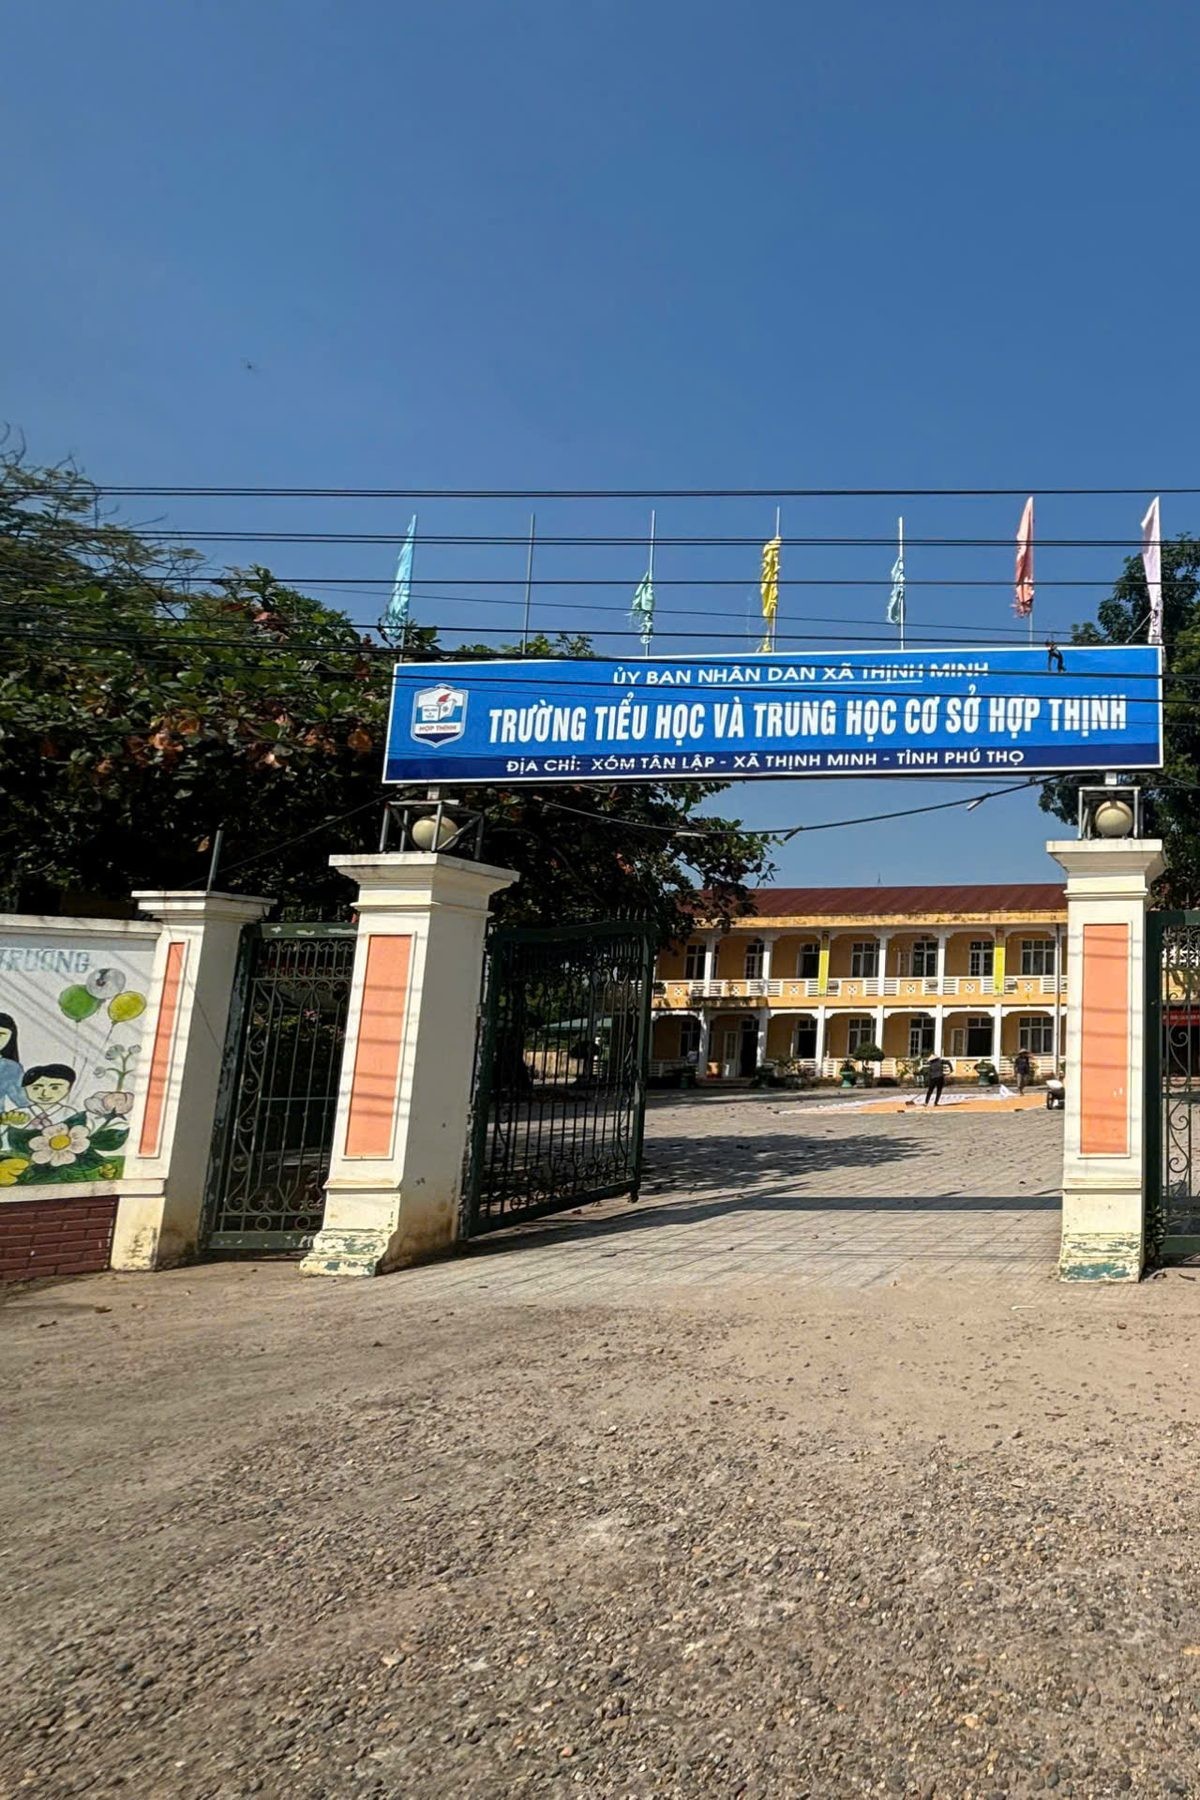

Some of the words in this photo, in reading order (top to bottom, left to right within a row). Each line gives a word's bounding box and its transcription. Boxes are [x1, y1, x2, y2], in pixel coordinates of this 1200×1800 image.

[613, 666, 641, 685] ỦY
[646, 669, 691, 685] BAN
[698, 665, 761, 684] NHÂN
[822, 662, 855, 680] XÃ
[930, 662, 989, 678] MINH
[489, 699, 587, 743] TRƯỜNG
[595, 690, 648, 741] TIỂU
[654, 702, 705, 746] HỌC
[713, 695, 744, 739] VÀ
[753, 700, 836, 738] TRUNG
[845, 698, 897, 743] HỌC
[904, 695, 941, 735] CƠ
[945, 683, 982, 734] SỞ
[988, 693, 1041, 739] HỢP
[1047, 694, 1127, 737] THỊNH
[506, 757, 538, 775] ĐỊA
[544, 754, 581, 771] CHỈ:
[591, 753, 636, 771] XÓM
[641, 753, 677, 770] TÂN
[682, 753, 715, 774] LẬP
[733, 751, 760, 768] XÃ
[764, 752, 821, 770] THỊNH
[827, 752, 878, 767] MINH
[896, 749, 939, 765] TỈNH
[945, 747, 981, 763] PHÚ
[986, 749, 1025, 767] THỌ
